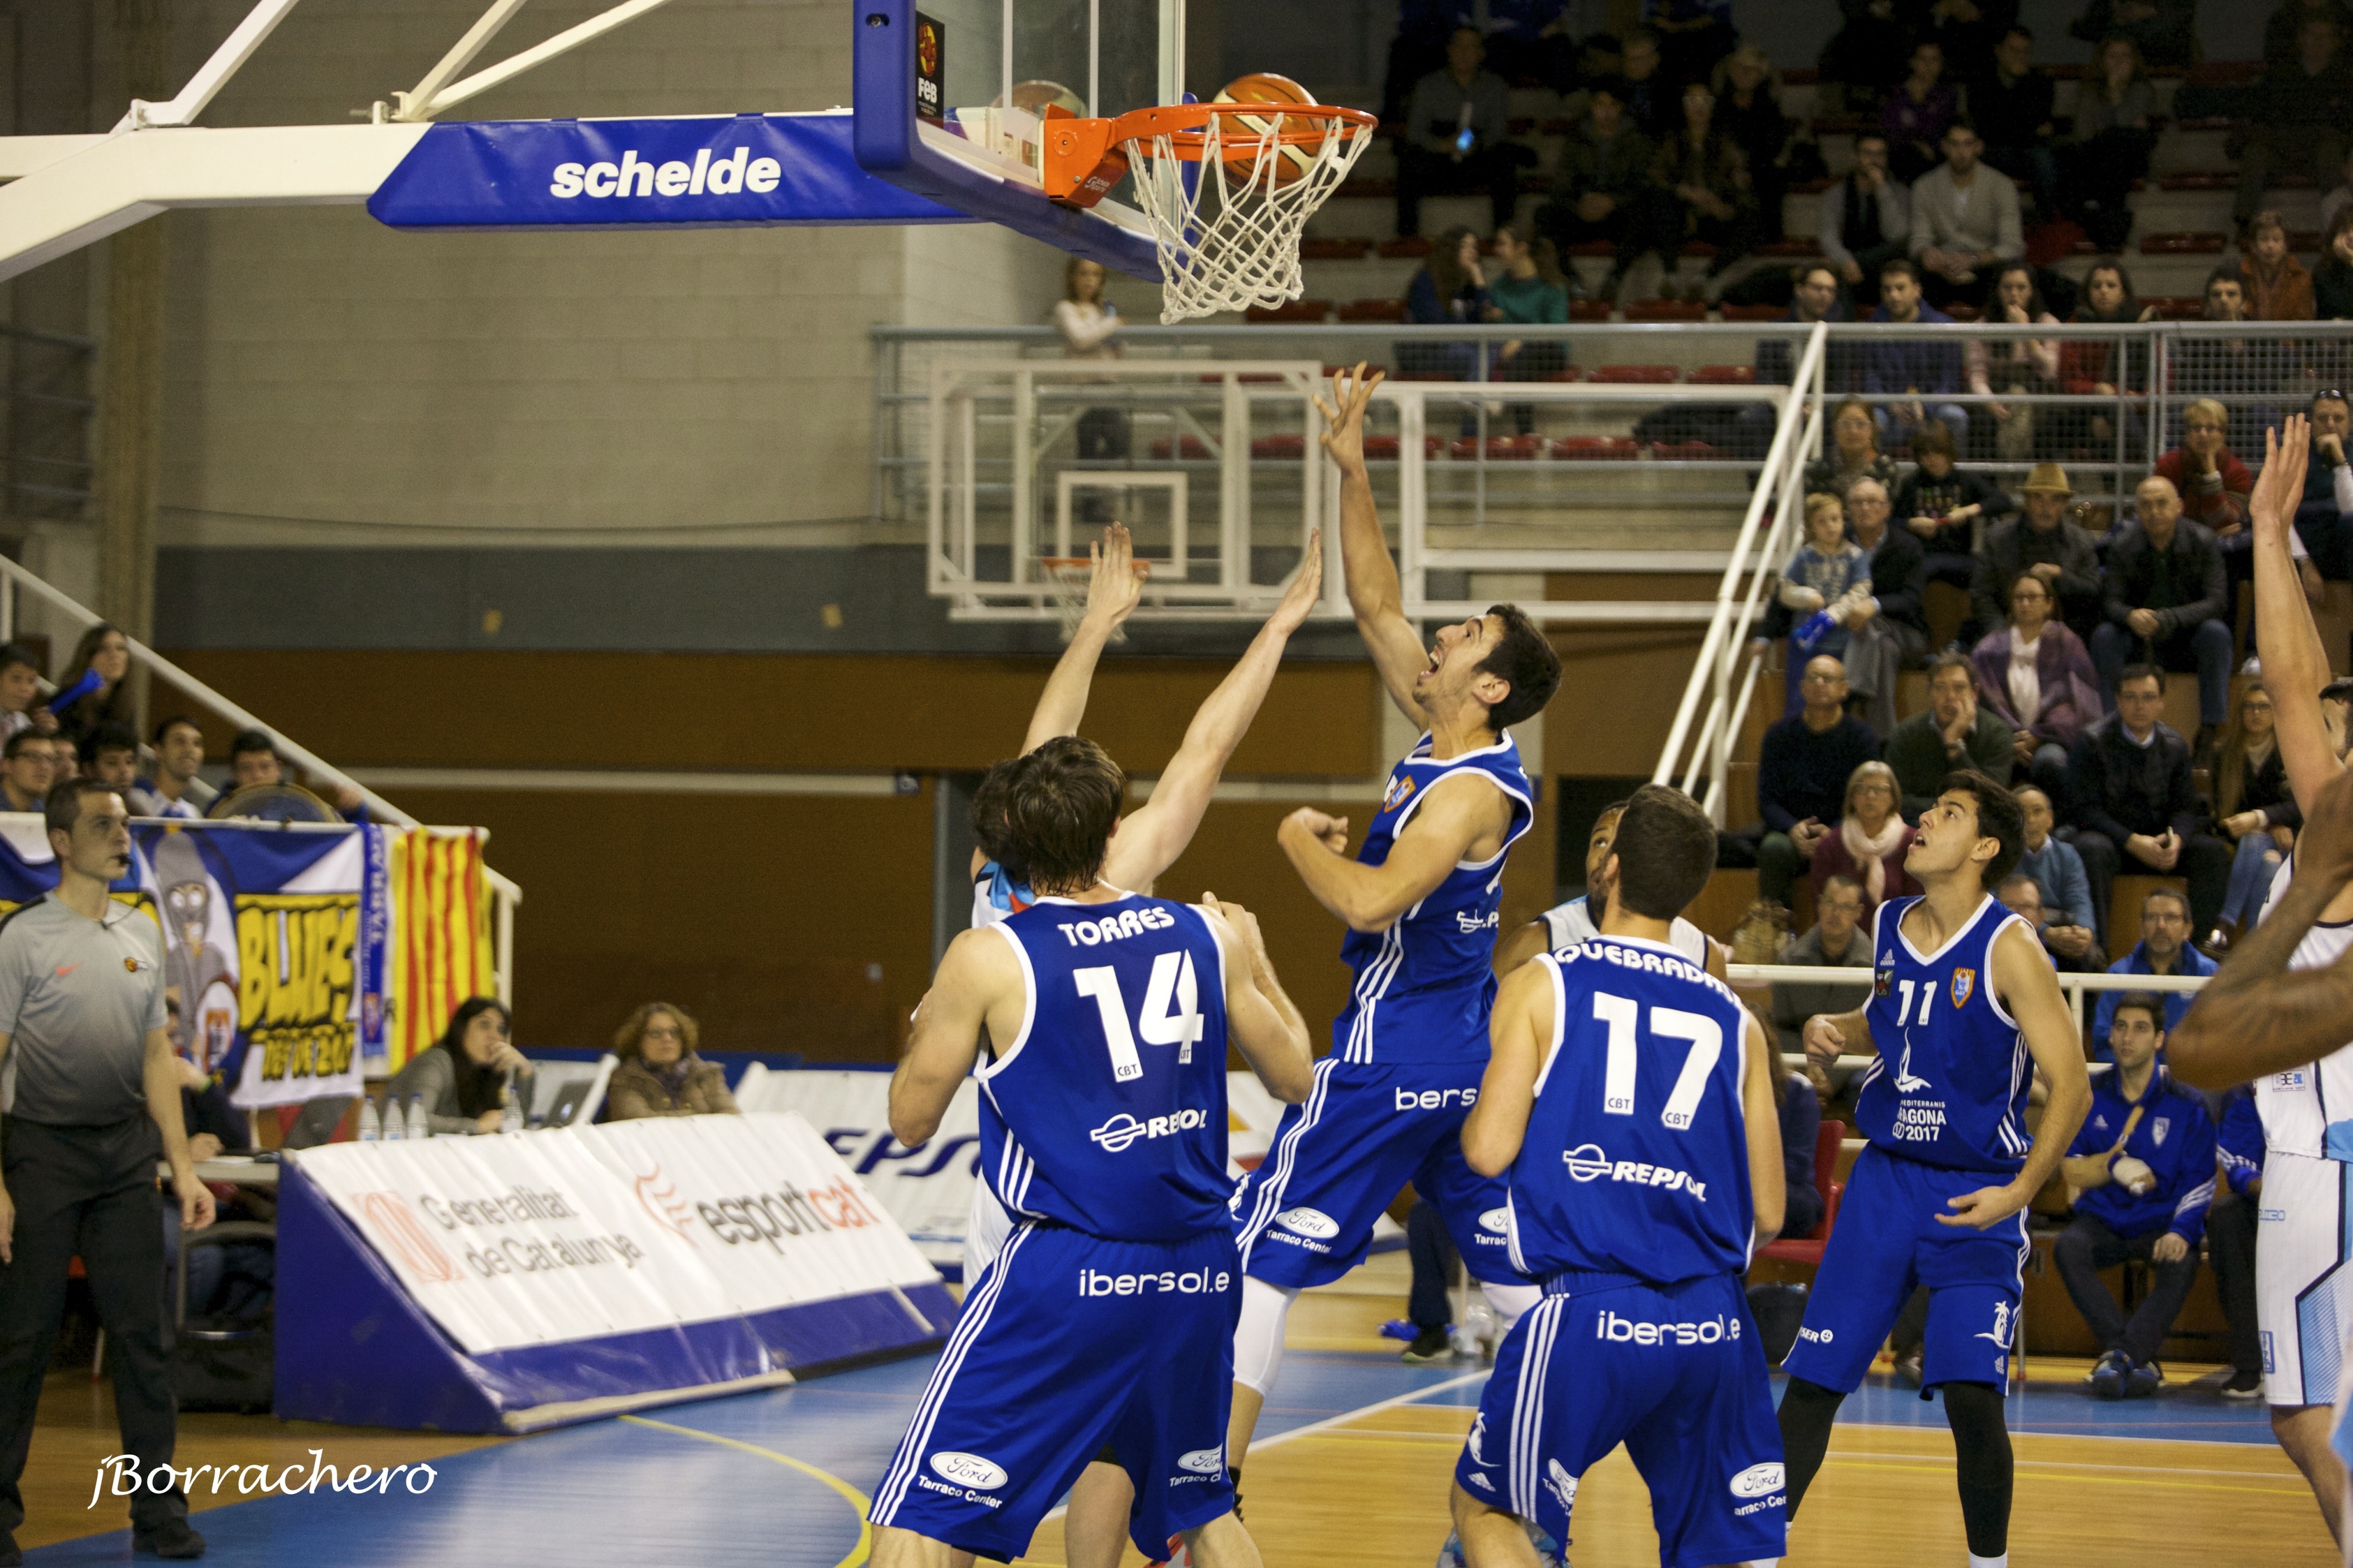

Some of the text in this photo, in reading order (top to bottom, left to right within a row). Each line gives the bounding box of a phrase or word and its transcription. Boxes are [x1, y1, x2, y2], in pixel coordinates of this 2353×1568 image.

[550, 147, 781, 198] schelde
[1057, 907, 1174, 946] TORRES
[1072, 948, 1204, 1083] 14
[1897, 979, 1938, 1027] 11
[1180, 1049, 1190, 1059] CBT
[1593, 991, 1723, 1130] 17
[1117, 1064, 1137, 1077] CBT
[1608, 1097, 1630, 1109] CBT
[1665, 1112, 1690, 1126] CBT
[1905, 1125, 1940, 1141] 2017
[823, 1127, 980, 1178] EPS
[1611, 1161, 1706, 1202] REPSOL
[420, 1185, 580, 1230] Generalitat
[1289, 1211, 1326, 1232] Ford
[1267, 1229, 1301, 1245] Tarraco
[947, 1457, 993, 1483] Ford
[1170, 1476, 1207, 1487] Tarraco
[1744, 1468, 1780, 1491] Ford
[919, 1474, 1003, 1508] Tarraco Center
